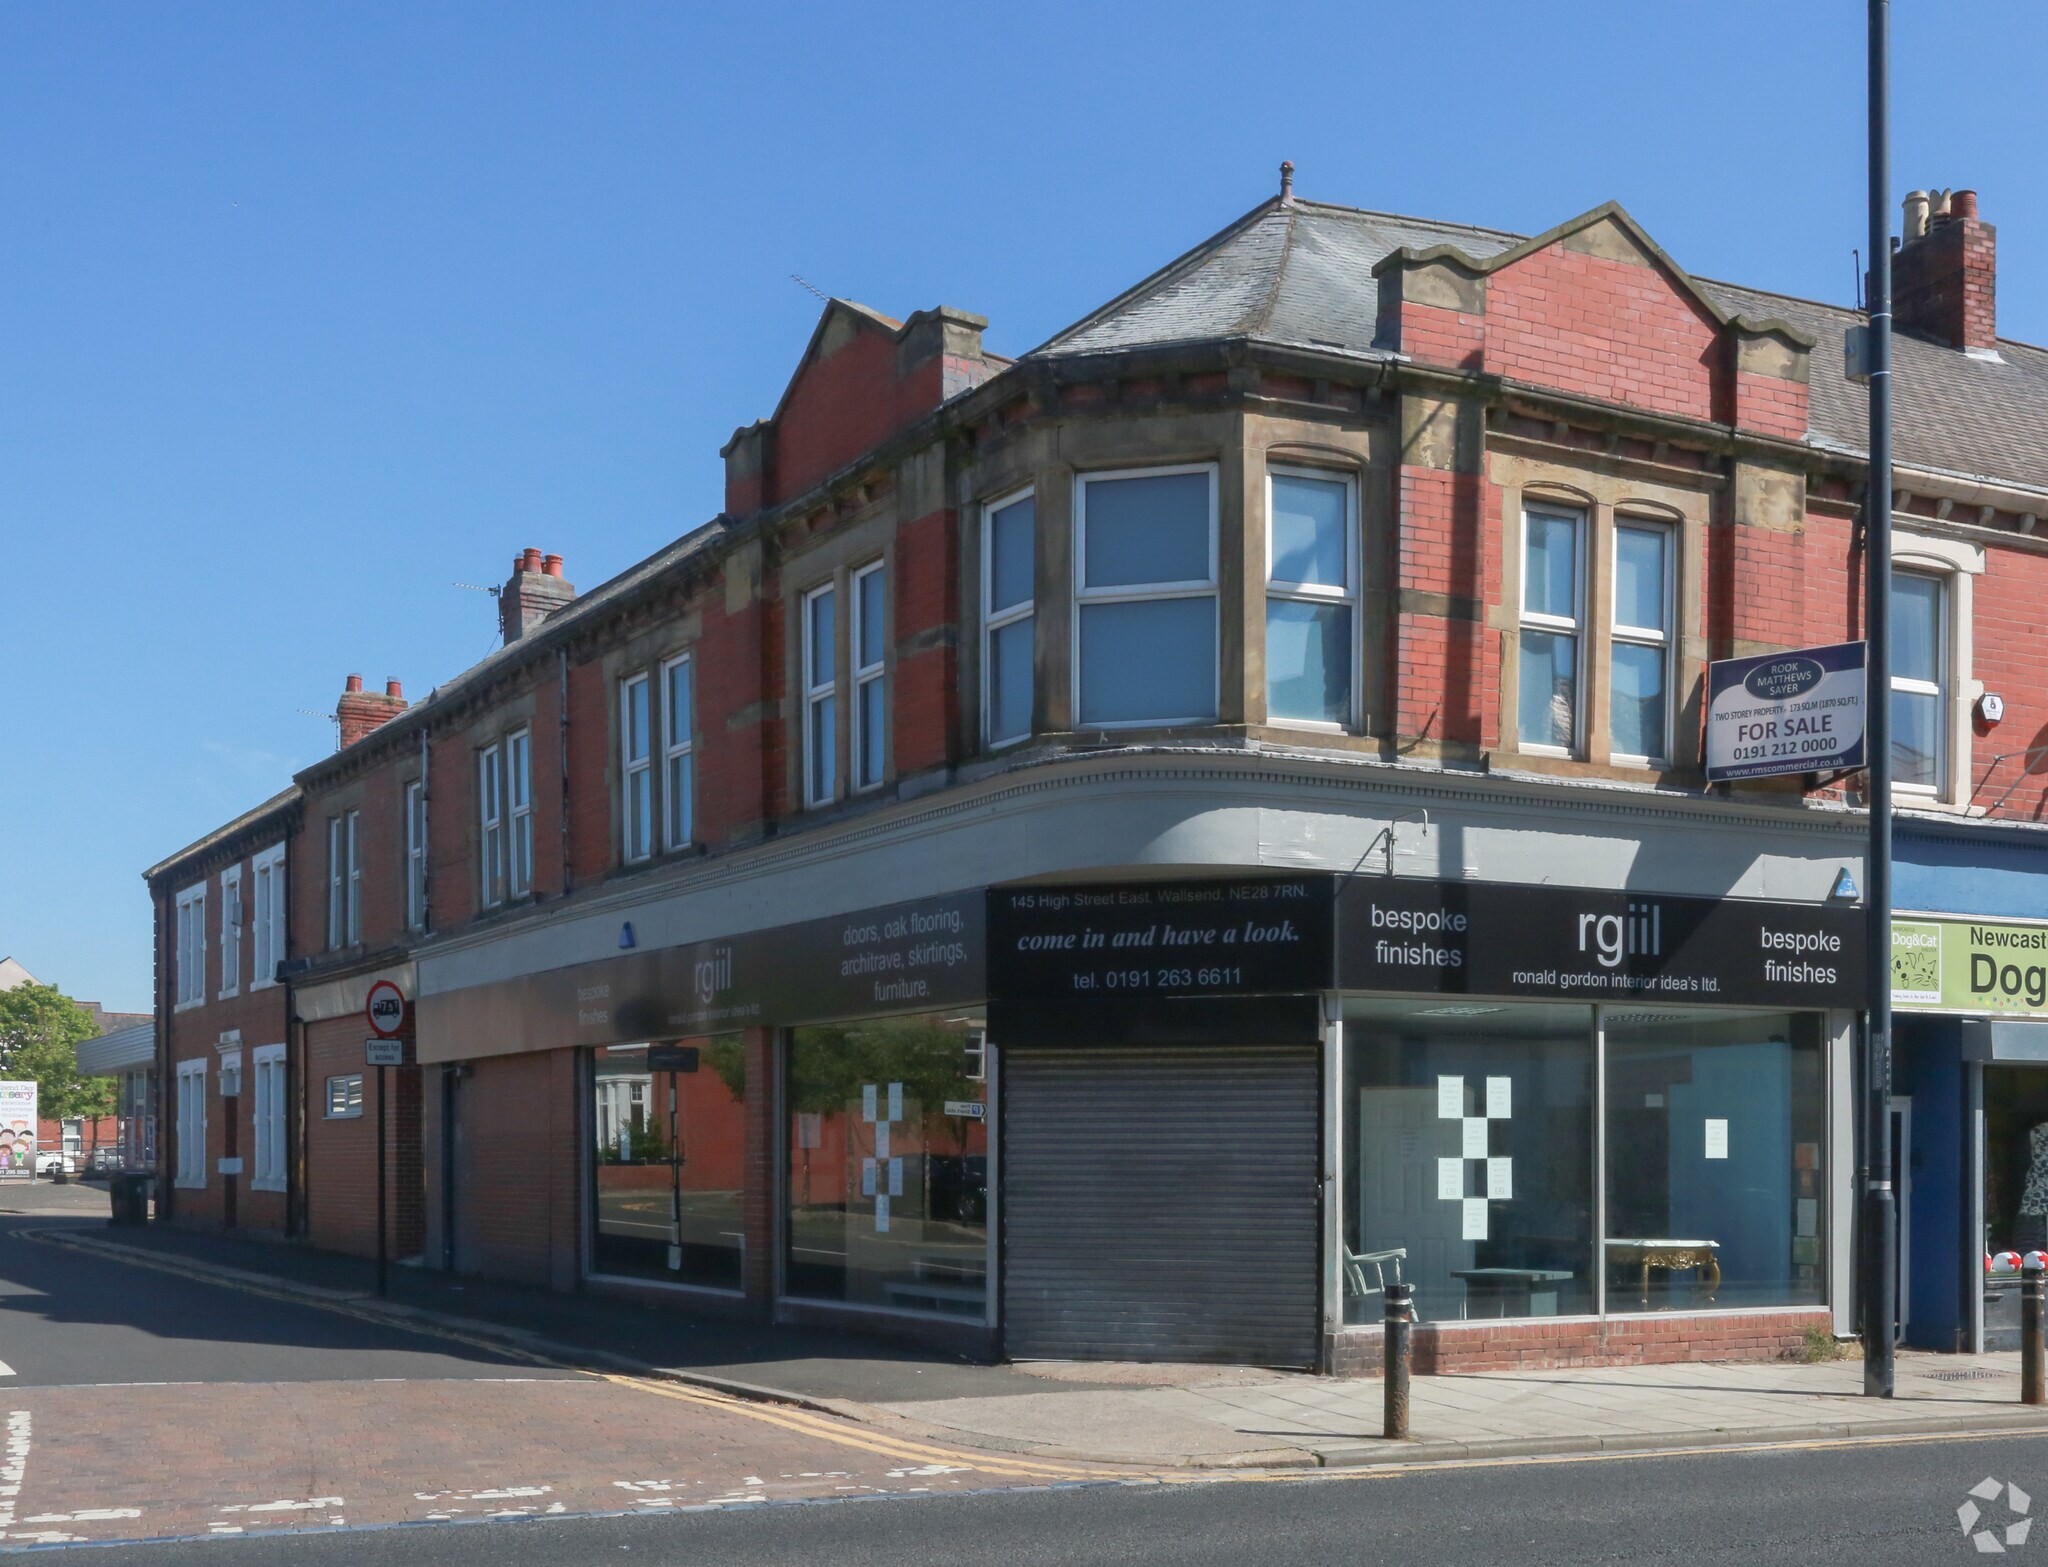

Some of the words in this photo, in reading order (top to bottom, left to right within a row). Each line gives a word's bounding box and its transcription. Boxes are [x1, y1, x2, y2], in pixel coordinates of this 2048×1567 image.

[1757, 671, 1812, 687] MATTHEWS
[1771, 663, 1798, 675] ROOK
[1769, 683, 1799, 696] SAYER
[1715, 713, 1730, 721] TWO
[1730, 710, 1752, 720] STOREY
[1789, 703, 1801, 713] 173
[1738, 721, 1778, 742] FOR
[1784, 714, 1832, 737] SALE
[1733, 745, 1767, 761] 0191
[1771, 741, 1797, 756] 212
[1801, 737, 1837, 753] 0000
[1726, 757, 1845, 777] www.rmscommercial.co.uk
[1011, 895, 1035, 909] 145
[1039, 895, 1070, 910] High
[1074, 893, 1115, 906] Street
[1229, 886, 1269, 900] NE28
[1273, 884, 1309, 898] 7RN.
[843, 924, 880, 946] doors,
[884, 915, 907, 939] oak
[911, 908, 964, 934] flooring,
[1371, 904, 1468, 937] bespoke
[1017, 933, 1077, 950] come
[1083, 927, 1105, 949] in
[1112, 925, 1157, 947] and
[1161, 924, 1217, 946] have
[1222, 928, 1237, 944] a
[1243, 920, 1300, 943] look.
[1579, 903, 1660, 967] rgiil
[1761, 926, 1842, 957] bespoke
[1892, 932, 1937, 949] Dog&Cat
[1970, 926, 2047, 950] Newcast
[841, 951, 905, 977] architrave,
[908, 941, 967, 967] skirtings,
[1374, 940, 1463, 967] finishes
[694, 947, 732, 1004] rgiil
[1073, 972, 1100, 989] tel.
[1106, 970, 1150, 988] 0191
[1157, 968, 1192, 986] 263
[1198, 967, 1241, 985] 6611
[1512, 969, 1556, 985] ronald
[1560, 971, 1608, 989] gordon
[1611, 972, 1657, 989] interior
[1660, 974, 1698, 991] idea's
[1701, 976, 1721, 992] ltd.
[1764, 960, 1837, 986] finishes
[1970, 953, 2047, 1008] Dog
[874, 978, 930, 1001] furniture.
[578, 1008, 609, 1026] finishes
[368, 1043, 390, 1052] Except
[391, 1043, 400, 1051] for
